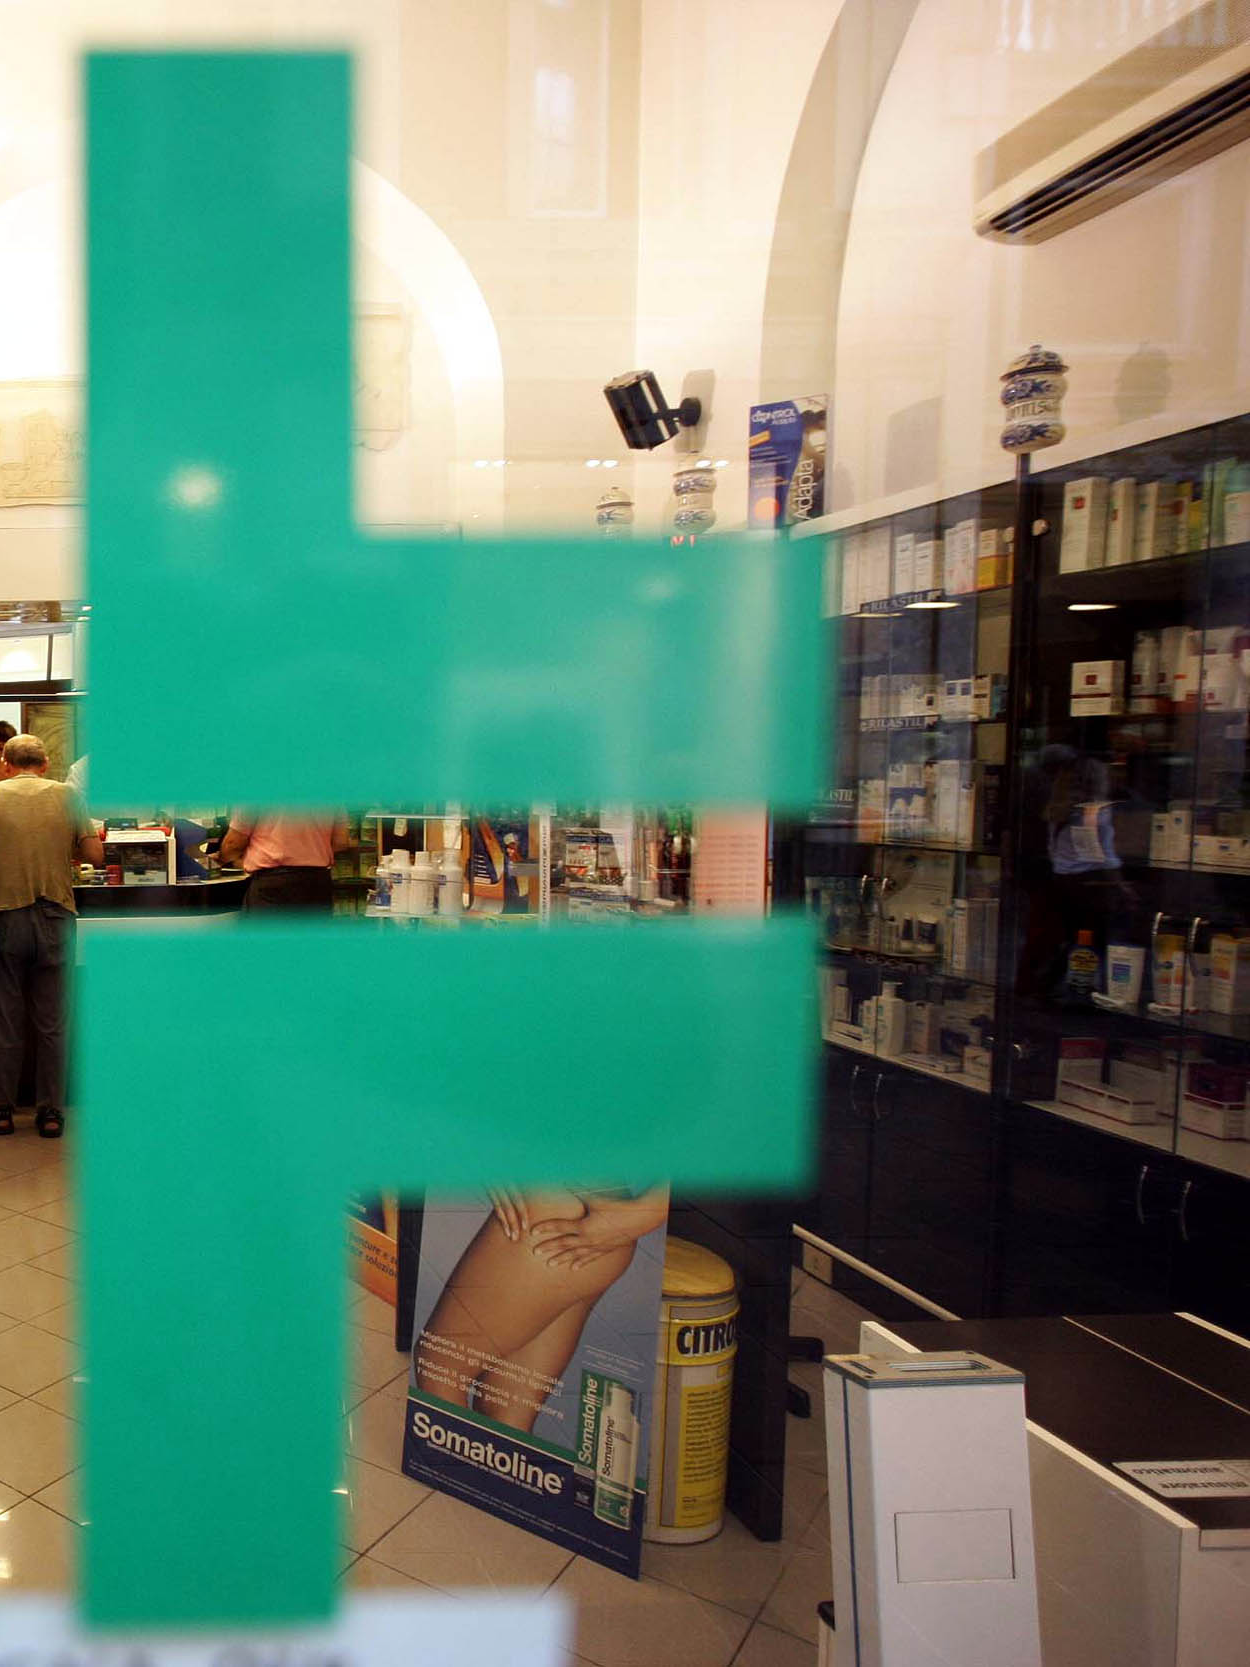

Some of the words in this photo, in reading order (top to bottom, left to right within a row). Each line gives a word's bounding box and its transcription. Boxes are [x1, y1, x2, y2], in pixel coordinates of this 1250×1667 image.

[412, 1411, 563, 1495] Somatoline
[578, 1376, 599, 1465] Somatoline
[601, 1415, 616, 1477] Somatoline
